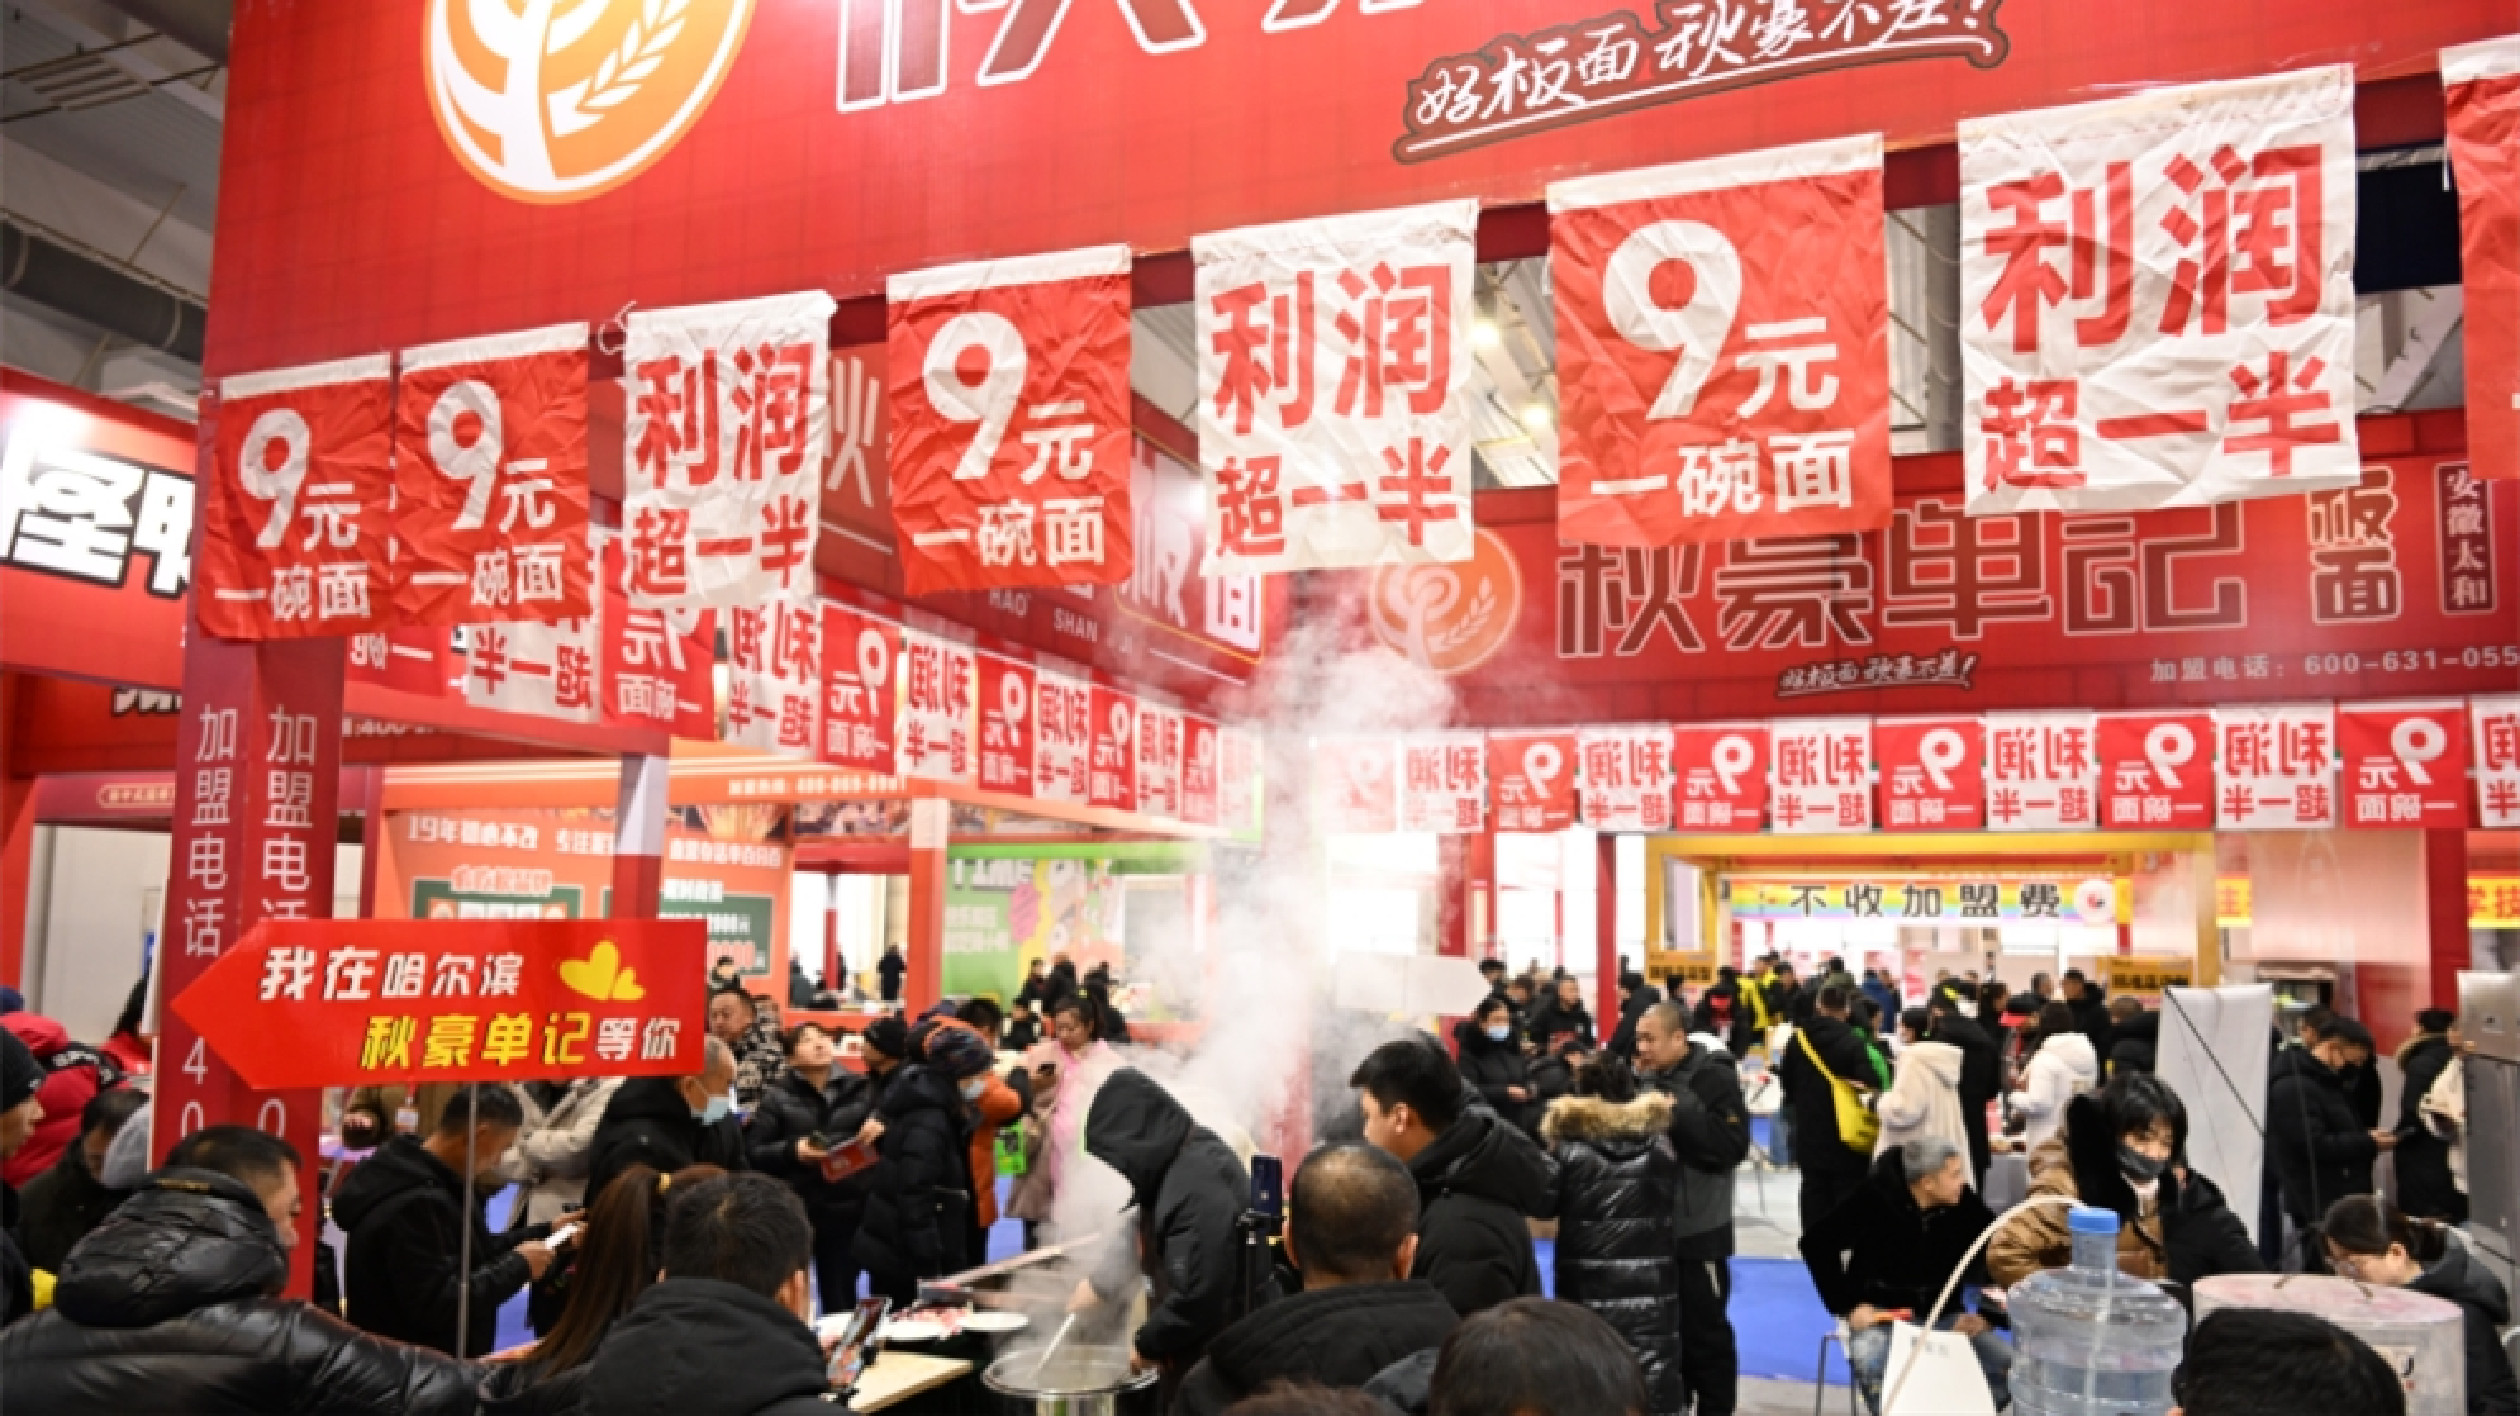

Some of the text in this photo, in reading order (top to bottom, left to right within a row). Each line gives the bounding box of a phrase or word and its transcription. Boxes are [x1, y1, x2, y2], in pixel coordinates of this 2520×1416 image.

[1416, 24, 1638, 124] 好板面
[1981, 143, 2324, 354] 利润
[1209, 261, 1453, 435] 利润
[1604, 219, 1841, 421] 9元
[428, 379, 557, 533] 9元
[635, 341, 814, 489] 利润
[923, 312, 1096, 485] 9元
[1981, 351, 2341, 494] 超一半
[239, 407, 362, 551] 9元
[913, 496, 1106, 568] 一碗面
[1216, 436, 1459, 557] 超一半
[1591, 428, 1856, 518] 一碗面
[215, 561, 372, 622] 一碗面
[410, 543, 566, 607] 一碗面
[628, 493, 810, 597] 超一半
[2305, 464, 2403, 626] 板面
[182, 703, 239, 957] 加盟电话
[1790, 883, 2062, 918] 不收加盟费
[259, 945, 524, 1002] 我在哈尔滨
[360, 1011, 682, 1071] 秋豪单记等你
